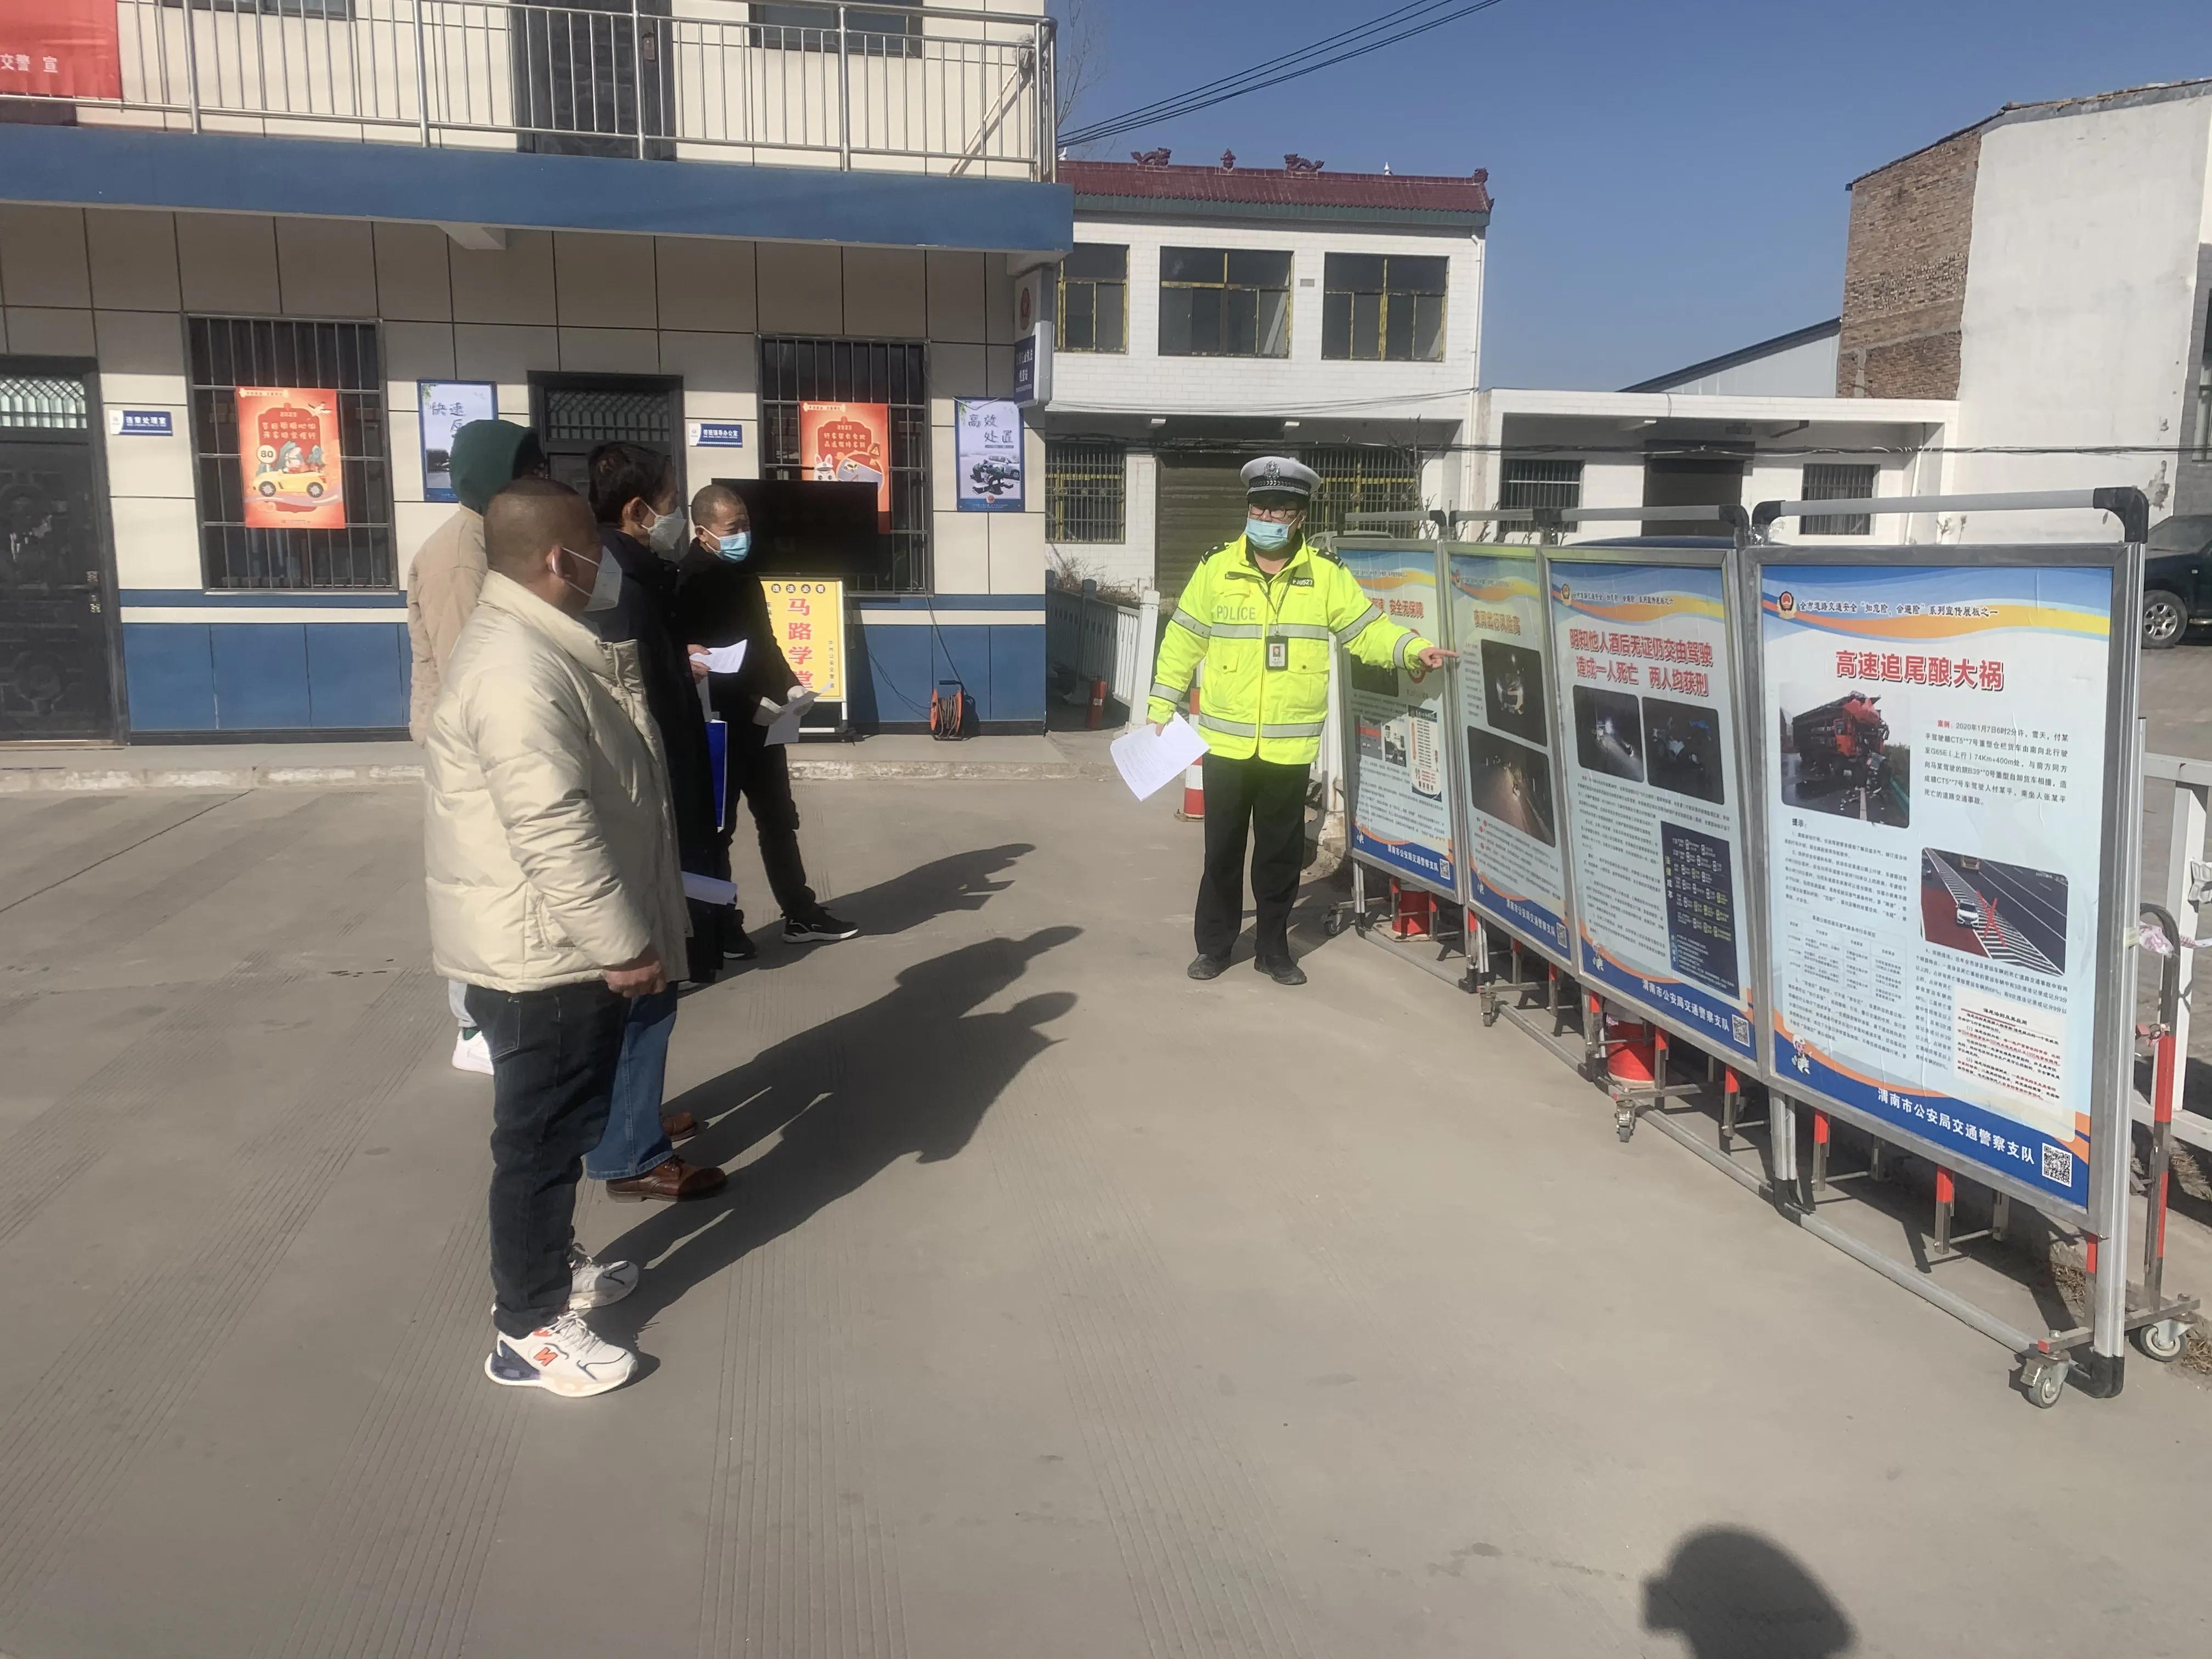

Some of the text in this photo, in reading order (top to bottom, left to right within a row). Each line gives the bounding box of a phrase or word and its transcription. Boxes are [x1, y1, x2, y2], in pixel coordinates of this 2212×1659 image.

[1, 54, 58, 73] 交警 宣
[430, 402, 465, 416] 快速
[968, 414, 998, 427] 高效
[984, 430, 1013, 443] 处置
[1216, 606, 1255, 620] POLICE
[787, 598, 814, 689] 马路学堂
[1570, 628, 1713, 666] 明知他人酒后无证仍交由驾驶
[1576, 656, 1708, 696] 造成一人死亡 两人均获刑
[1836, 650, 2003, 690] 高速追尾酿大祸
[1642, 979, 1729, 1031] 渭南市公安局交通警察支队
[1878, 1087, 2035, 1165] 渭南市公安局交通警察支队
